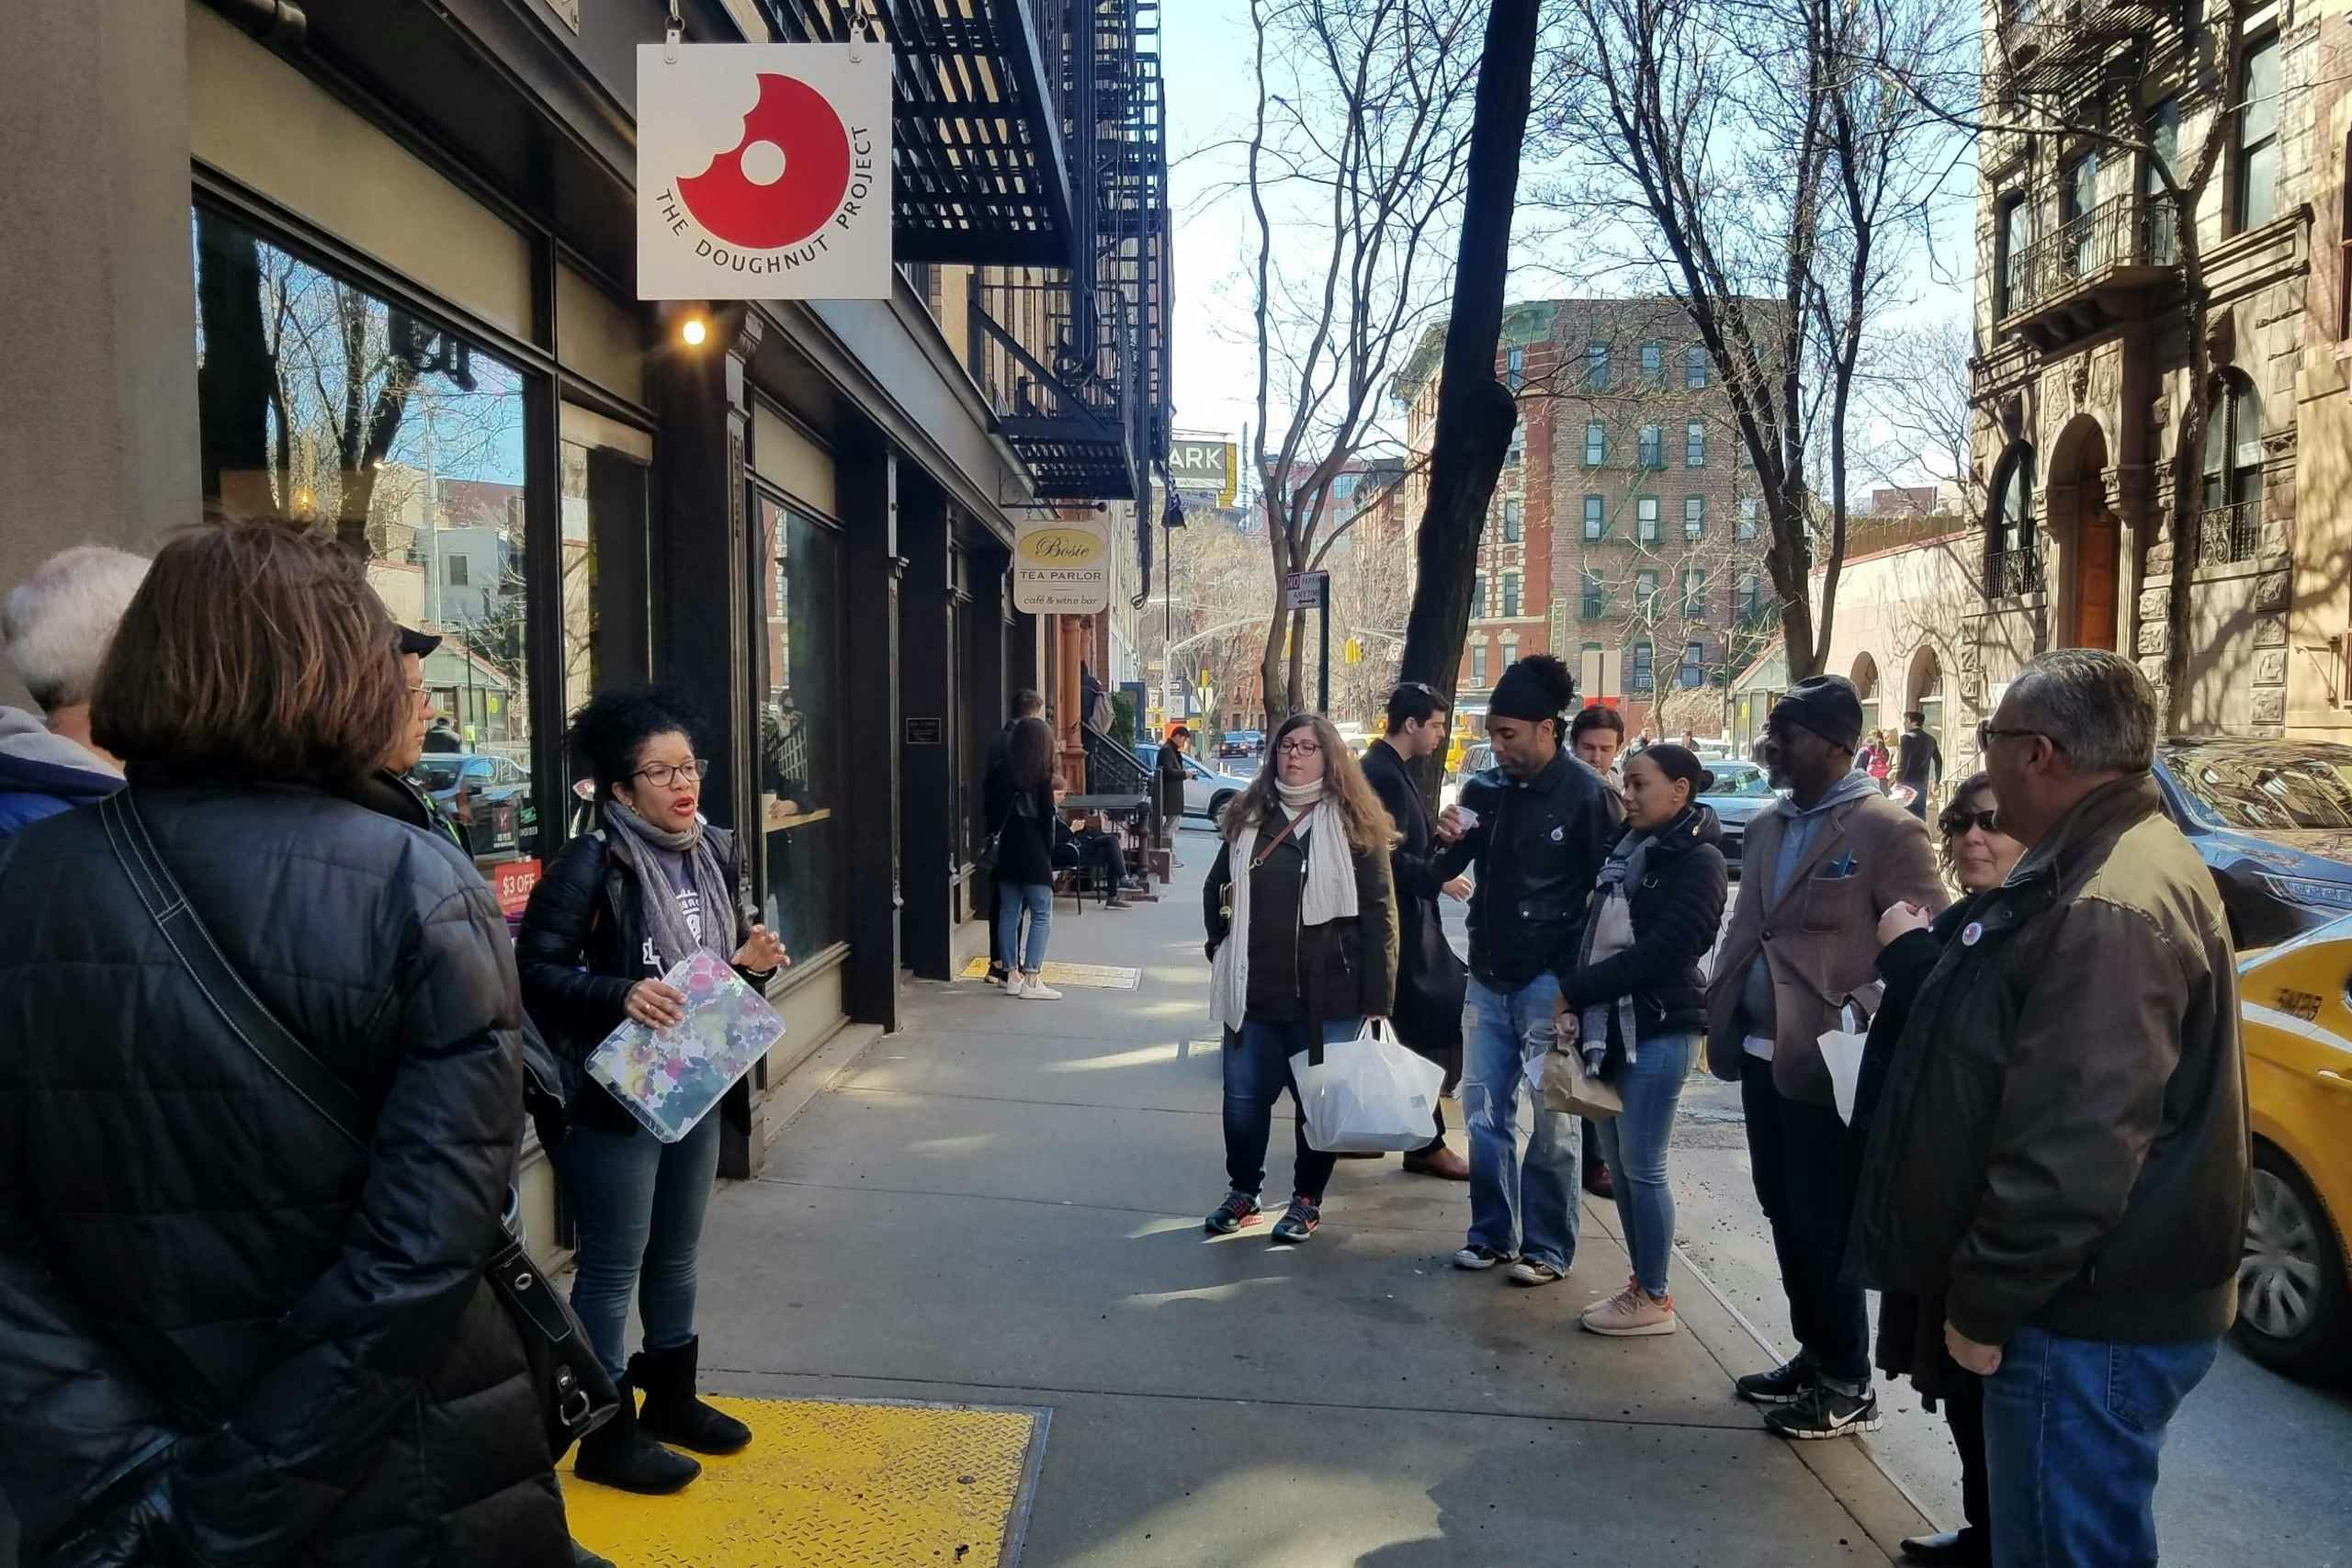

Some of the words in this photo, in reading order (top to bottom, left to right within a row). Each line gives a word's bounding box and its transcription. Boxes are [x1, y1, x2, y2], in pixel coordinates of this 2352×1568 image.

[656, 188, 689, 236] THE
[695, 234, 829, 274] DOUGHNUT
[835, 126, 872, 230] PROJECT
[1169, 447, 1222, 469] ARK
[1035, 536, 1090, 558] Bosie
[1020, 571, 1045, 581] TEA
[1050, 571, 1102, 581] PARLOR
[1287, 575, 1300, 589] NO
[1023, 594, 1044, 605] café
[1046, 595, 1055, 604] &
[1056, 595, 1079, 605] wine
[1080, 594, 1098, 605] bar
[503, 874, 515, 897] $3
[517, 873, 535, 893] OFF
